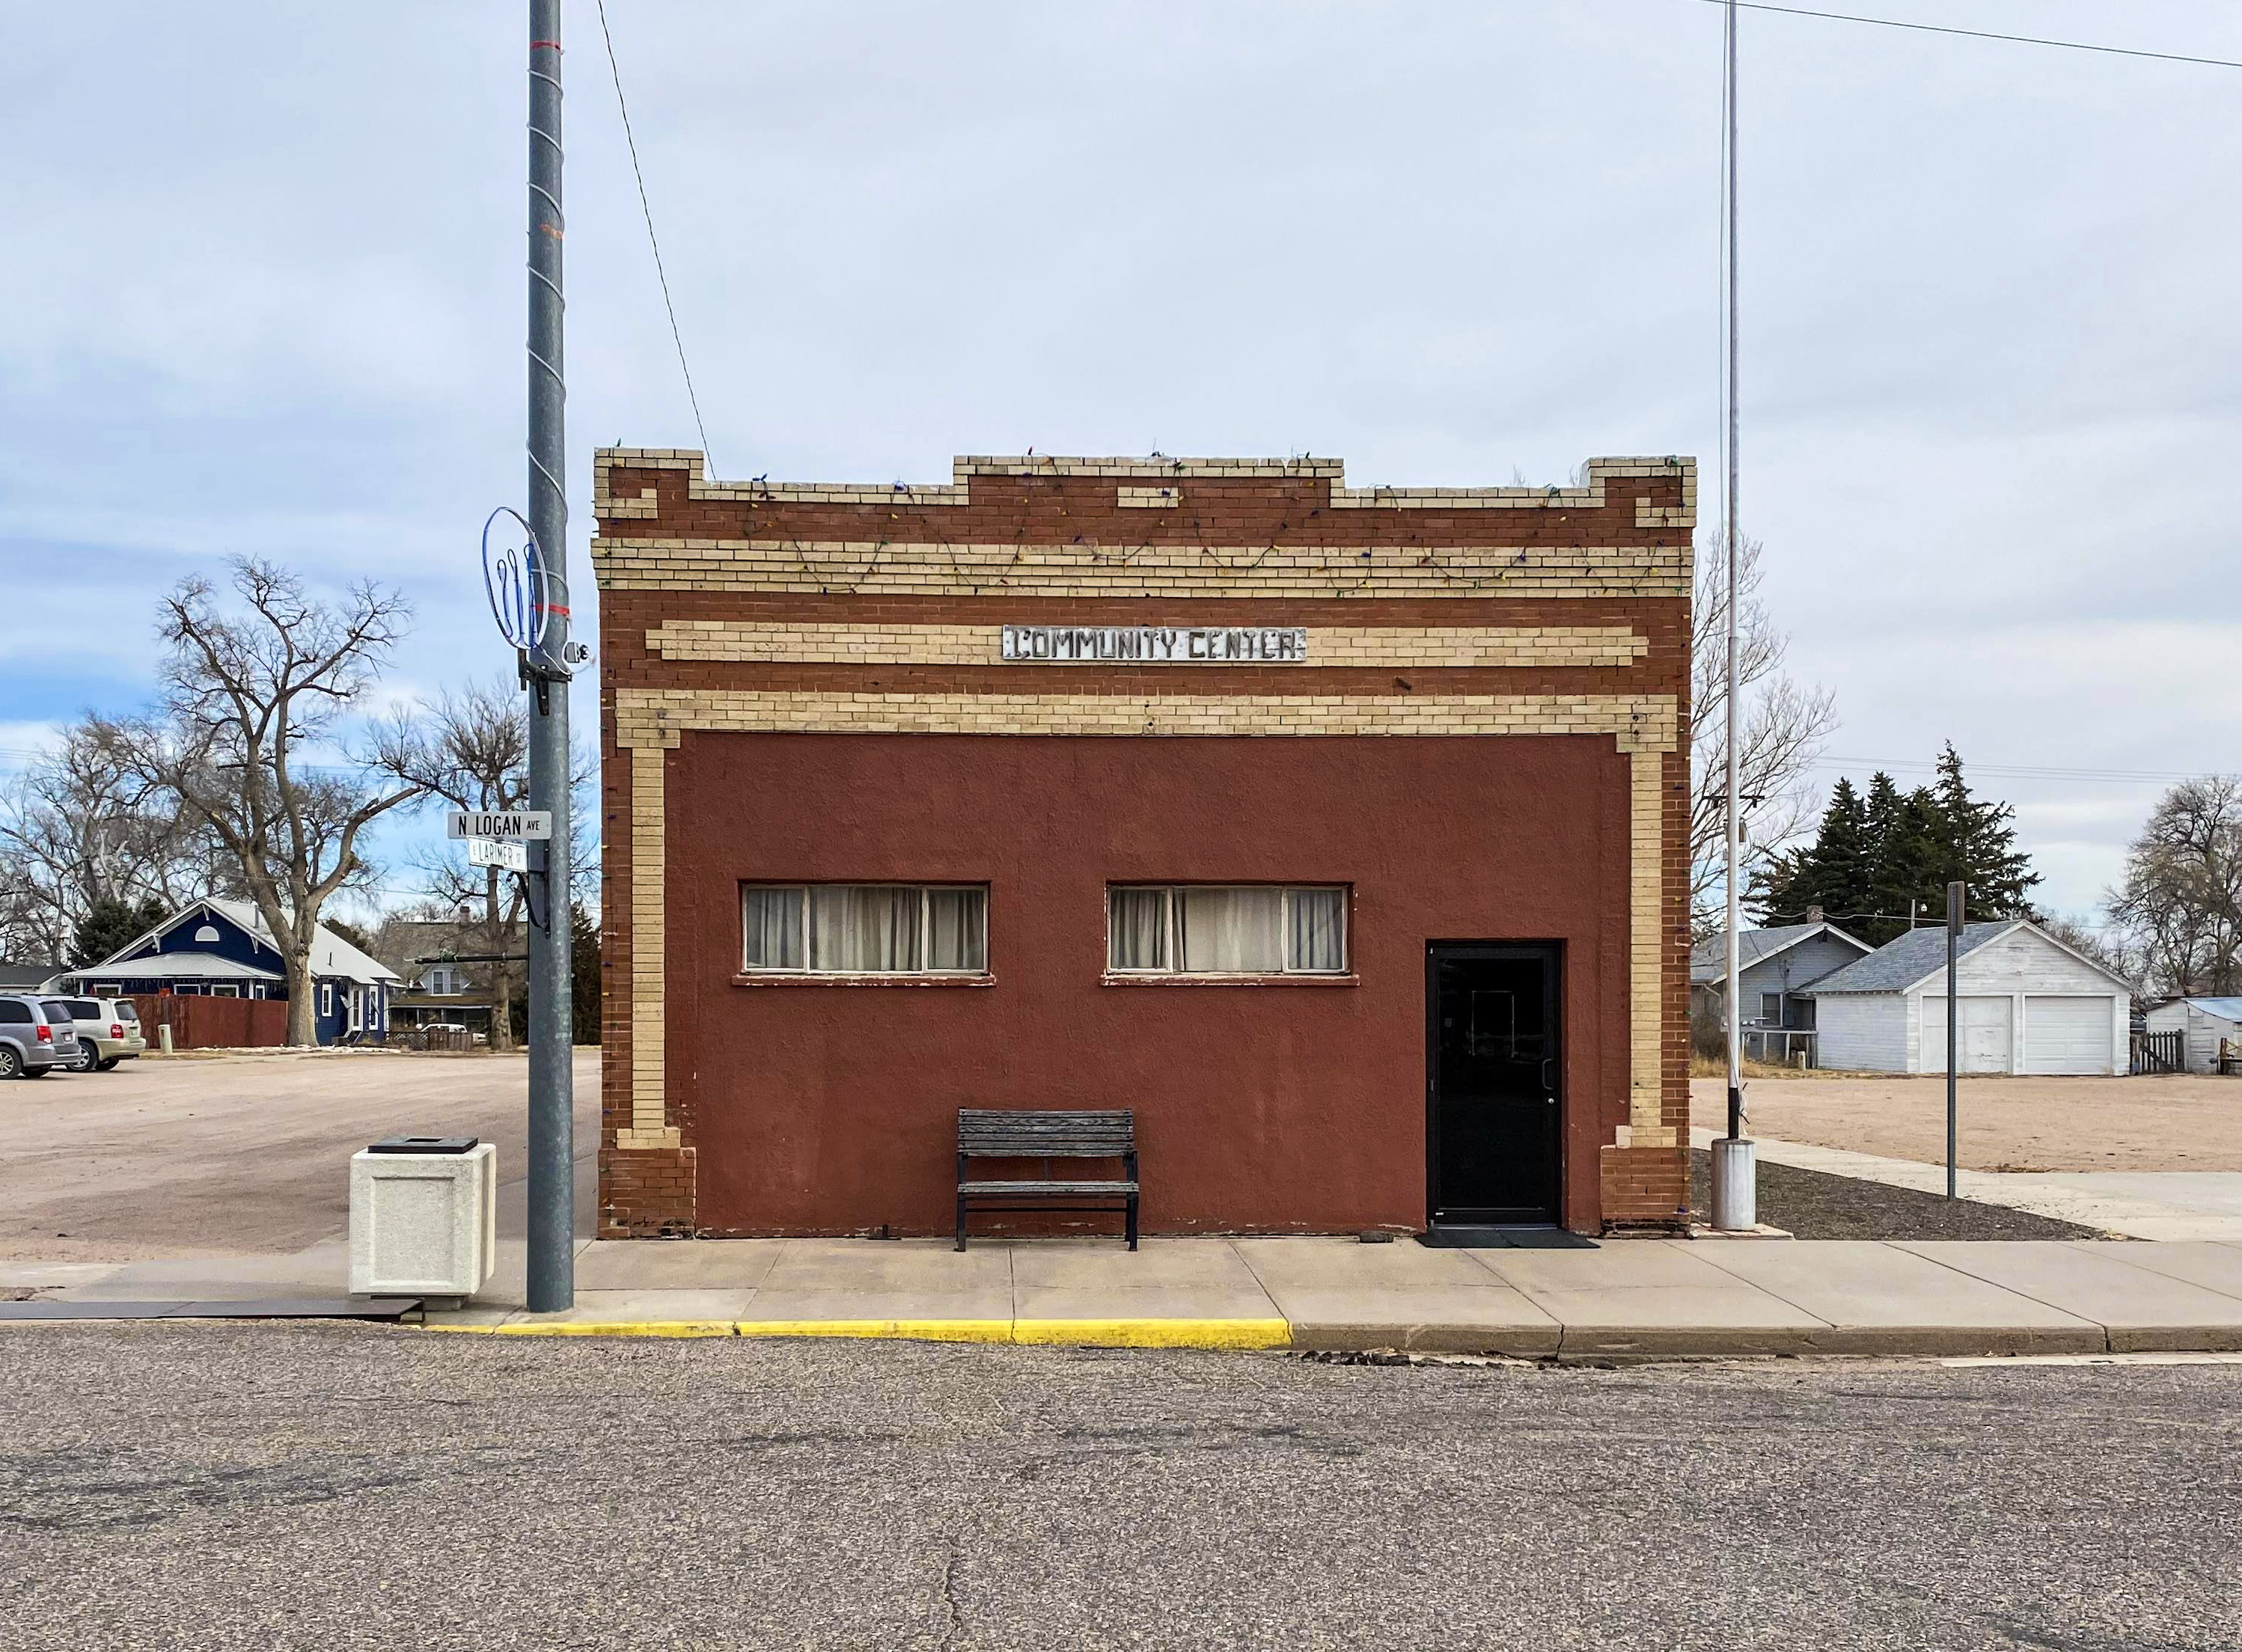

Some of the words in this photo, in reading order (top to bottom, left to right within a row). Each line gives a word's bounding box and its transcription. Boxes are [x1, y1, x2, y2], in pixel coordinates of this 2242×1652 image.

[1014, 629, 1176, 658] COMMUNITY
[1189, 630, 1295, 658] CENTER
[459, 816, 467, 835] N
[476, 816, 521, 836] LOGAN
[527, 821, 540, 830] AVE
[479, 842, 513, 866] LARIMER
